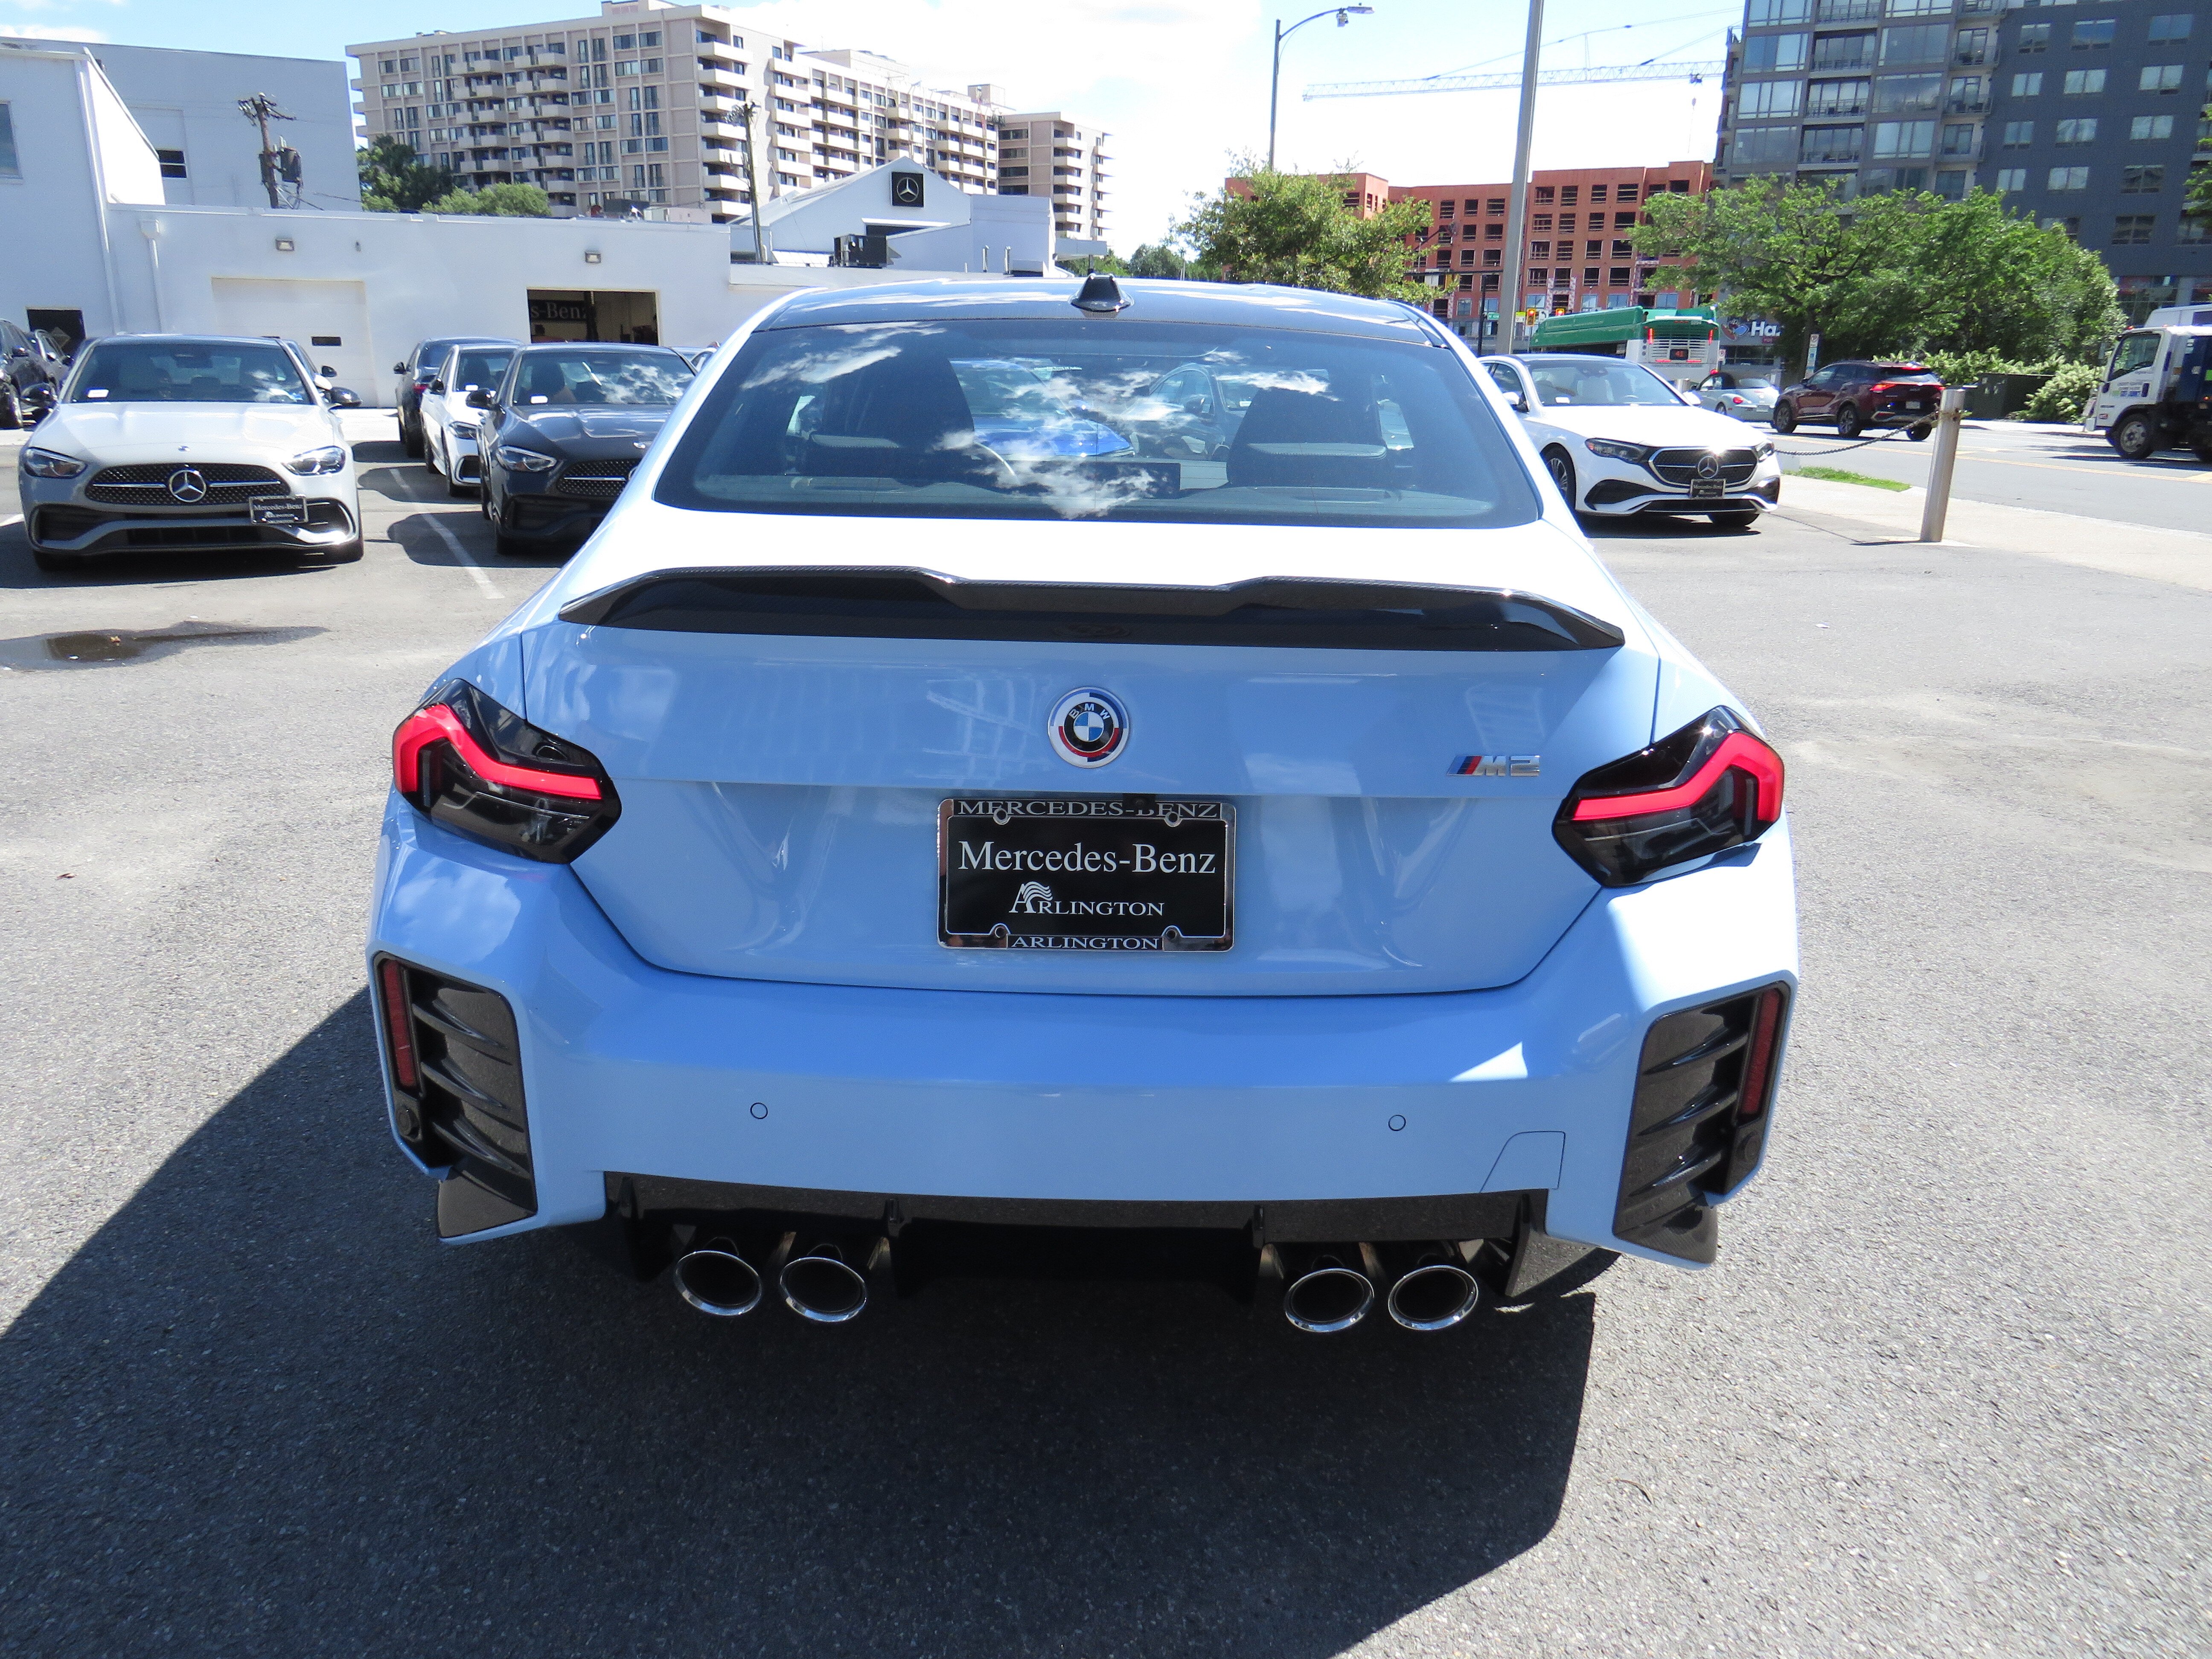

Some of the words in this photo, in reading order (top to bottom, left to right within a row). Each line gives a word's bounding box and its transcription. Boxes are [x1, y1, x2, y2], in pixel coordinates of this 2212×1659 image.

[1068, 703, 1110, 719] BMW
[1472, 755, 1540, 776] M2
[958, 841, 1216, 874] Mercedes-Benz
[1008, 882, 1164, 916] ARLINGTON
[1011, 936, 1158, 950] ARLINGTON
